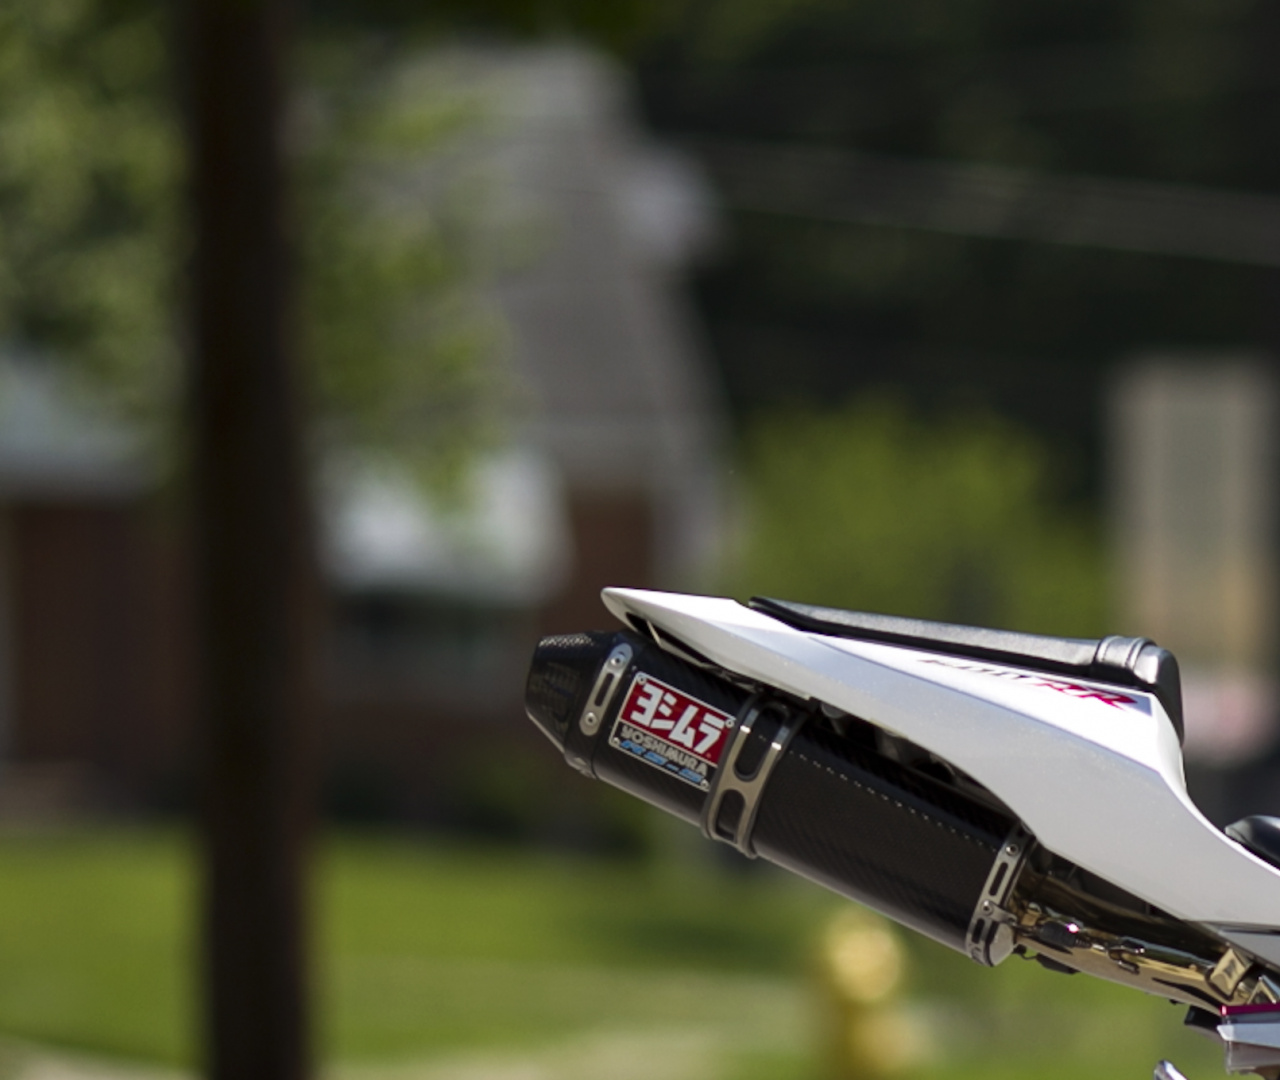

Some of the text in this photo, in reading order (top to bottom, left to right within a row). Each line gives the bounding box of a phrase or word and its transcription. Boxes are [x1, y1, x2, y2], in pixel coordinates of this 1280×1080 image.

[630, 683, 725, 754] ヨシムラ
[620, 725, 707, 776] YOSHIMURA
